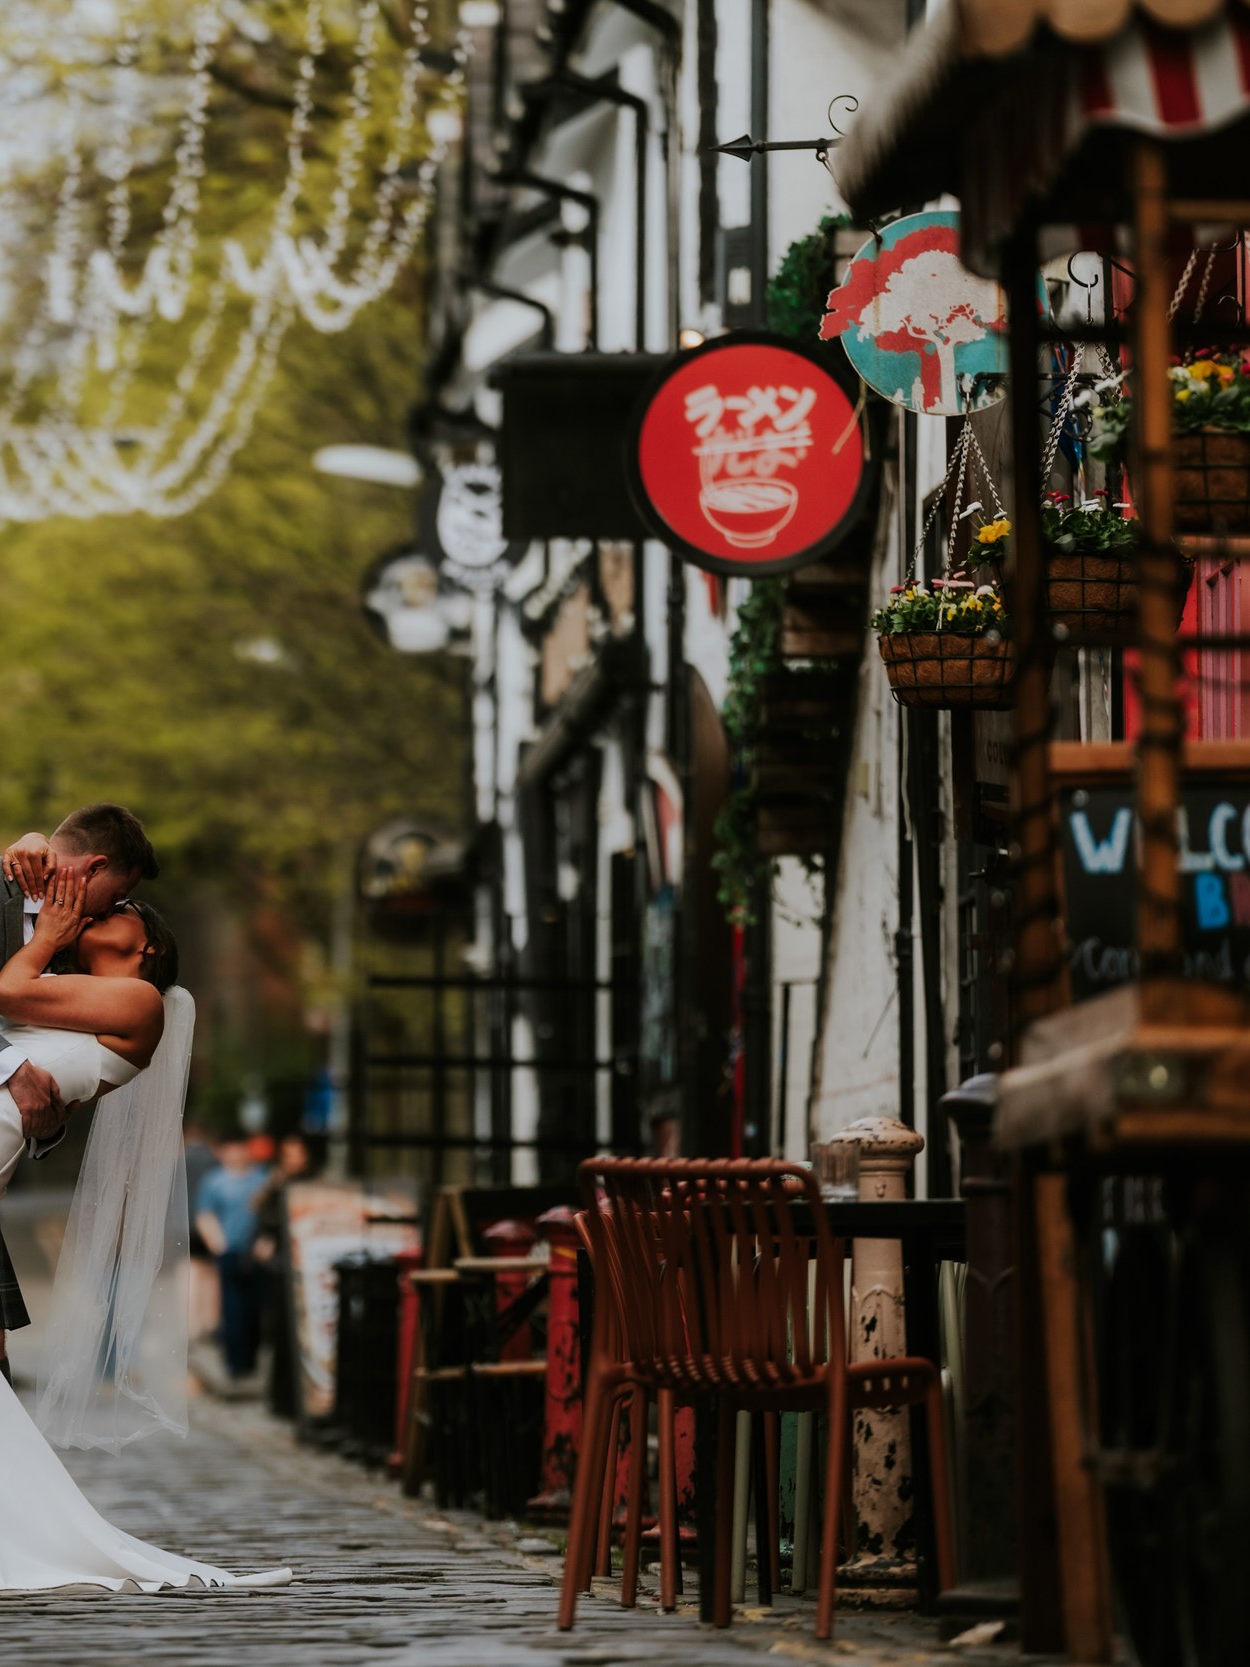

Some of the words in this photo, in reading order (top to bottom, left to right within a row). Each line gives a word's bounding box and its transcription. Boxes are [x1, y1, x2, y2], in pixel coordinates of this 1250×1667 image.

[684, 384, 818, 438] ラーメン
[1069, 802, 1250, 874] WLC
